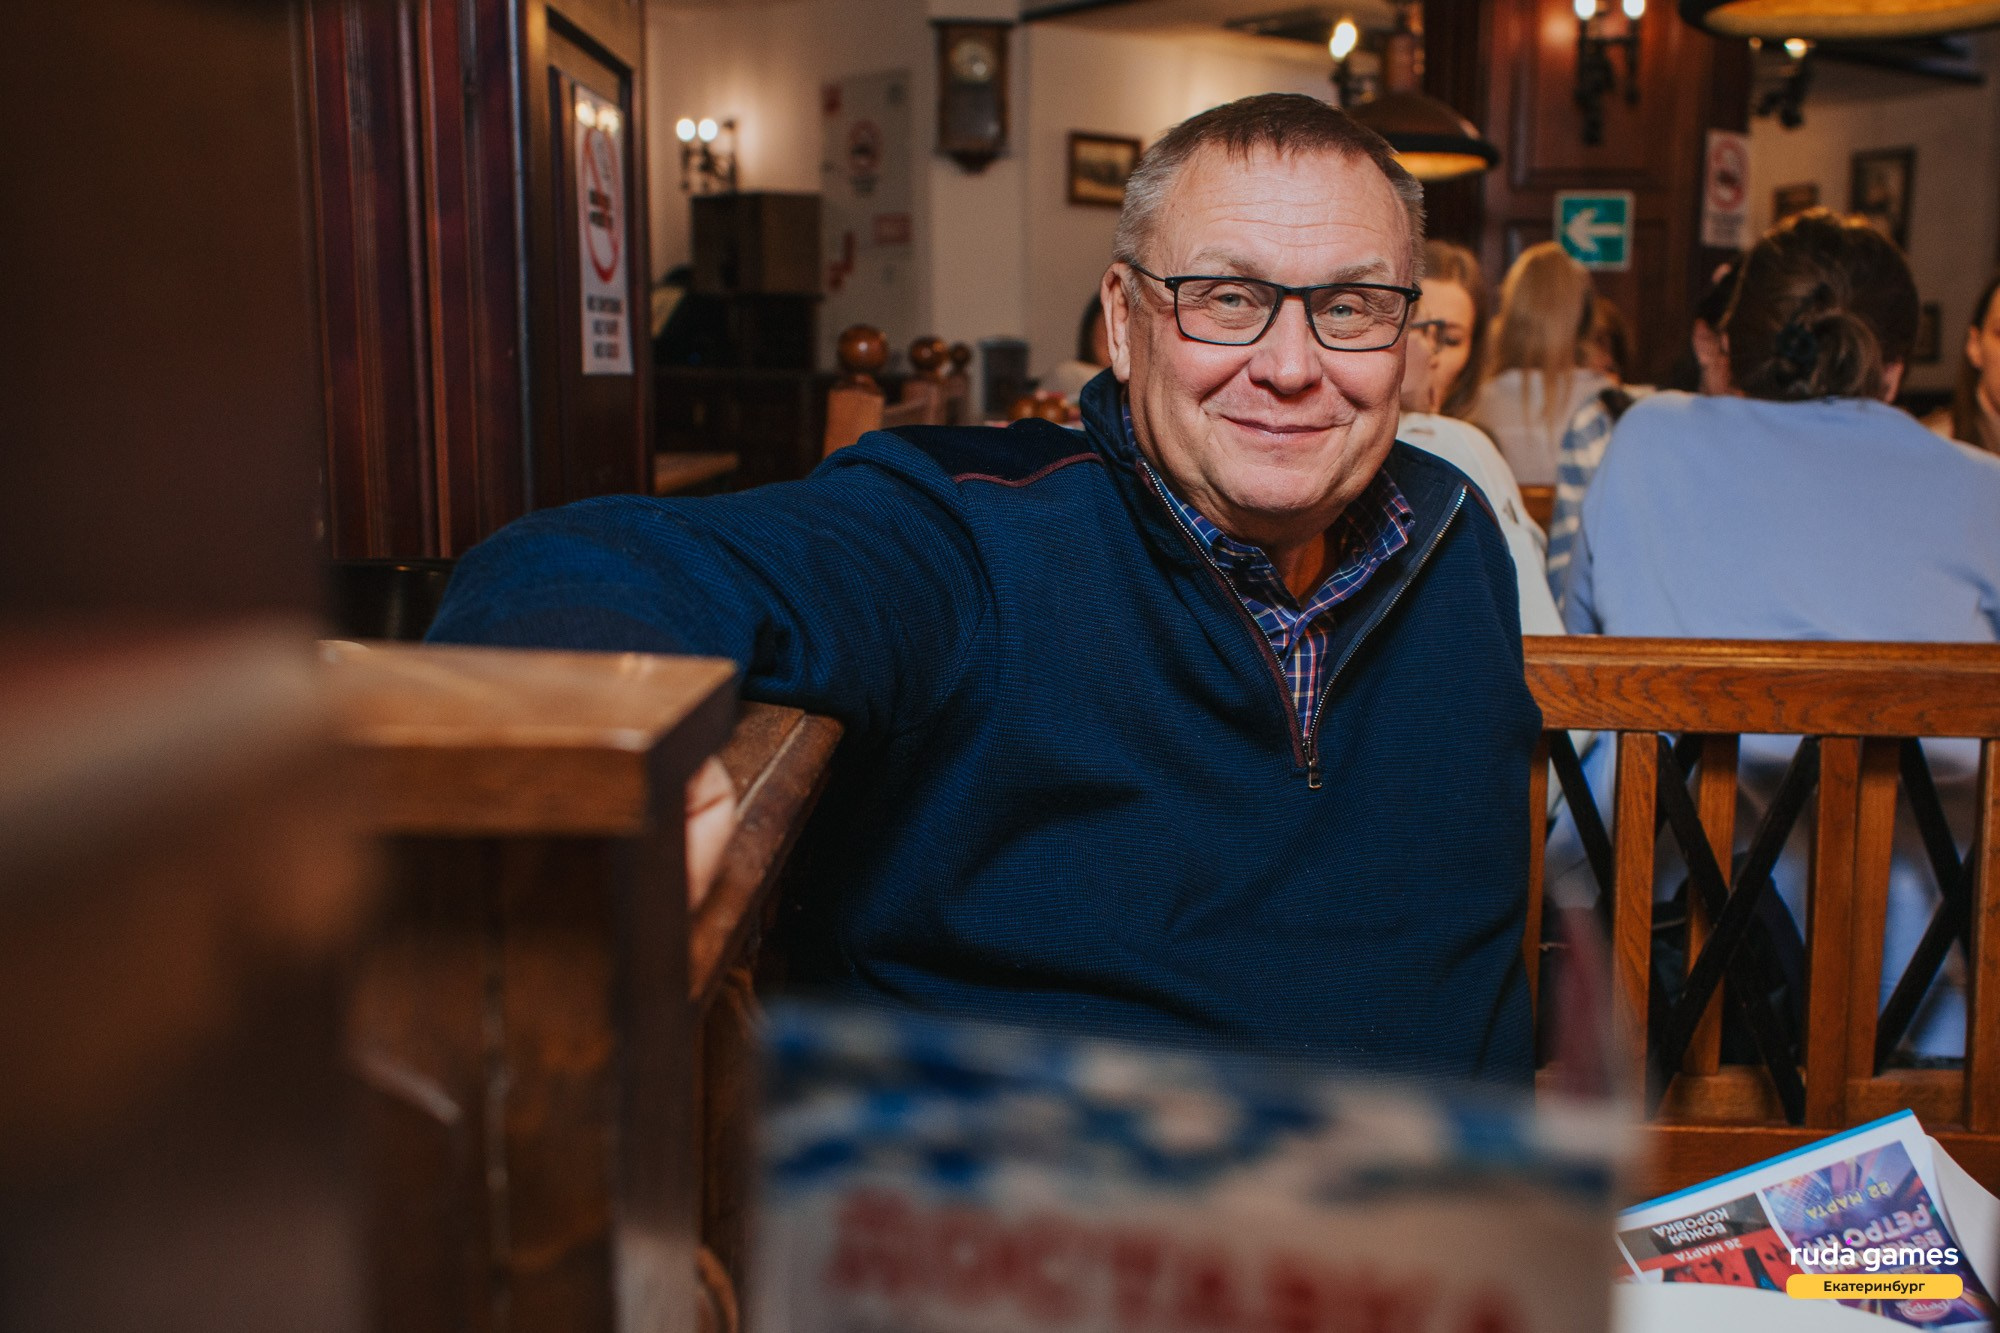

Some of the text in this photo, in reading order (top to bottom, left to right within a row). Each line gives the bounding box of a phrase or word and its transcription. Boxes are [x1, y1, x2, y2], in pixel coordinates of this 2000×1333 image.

[1806, 1191, 1863, 1219] МАРТА
[1652, 1207, 1730, 1238] КОРОВКА
[1668, 1222, 1727, 1246] БОЖЬЯ
[1843, 1204, 1932, 1248] РЕТРО
[1673, 1243, 1725, 1263] МАРТА
